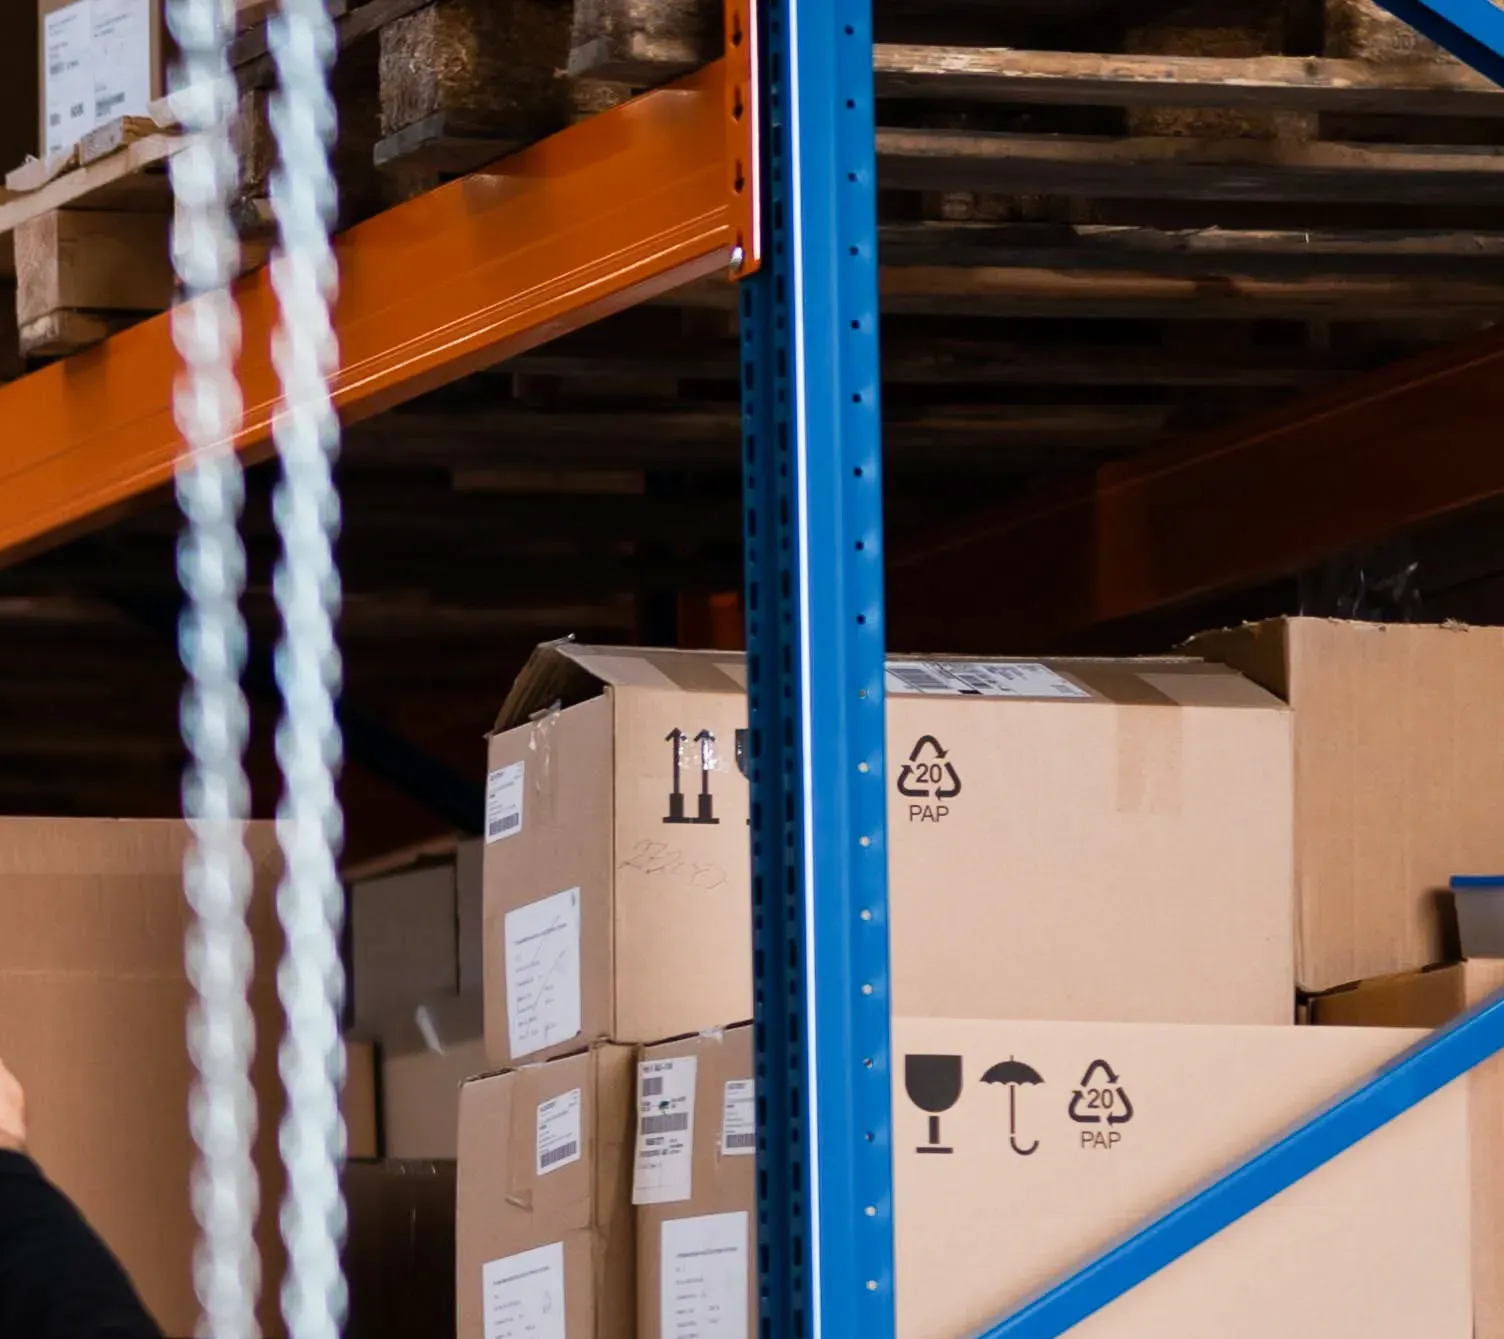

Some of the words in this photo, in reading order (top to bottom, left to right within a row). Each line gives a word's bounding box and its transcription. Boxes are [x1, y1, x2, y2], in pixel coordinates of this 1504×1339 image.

[916, 763, 942, 783] 20
[909, 805, 949, 822] PAP
[1088, 1089, 1113, 1109] 20
[1081, 1131, 1121, 1149] PAP
